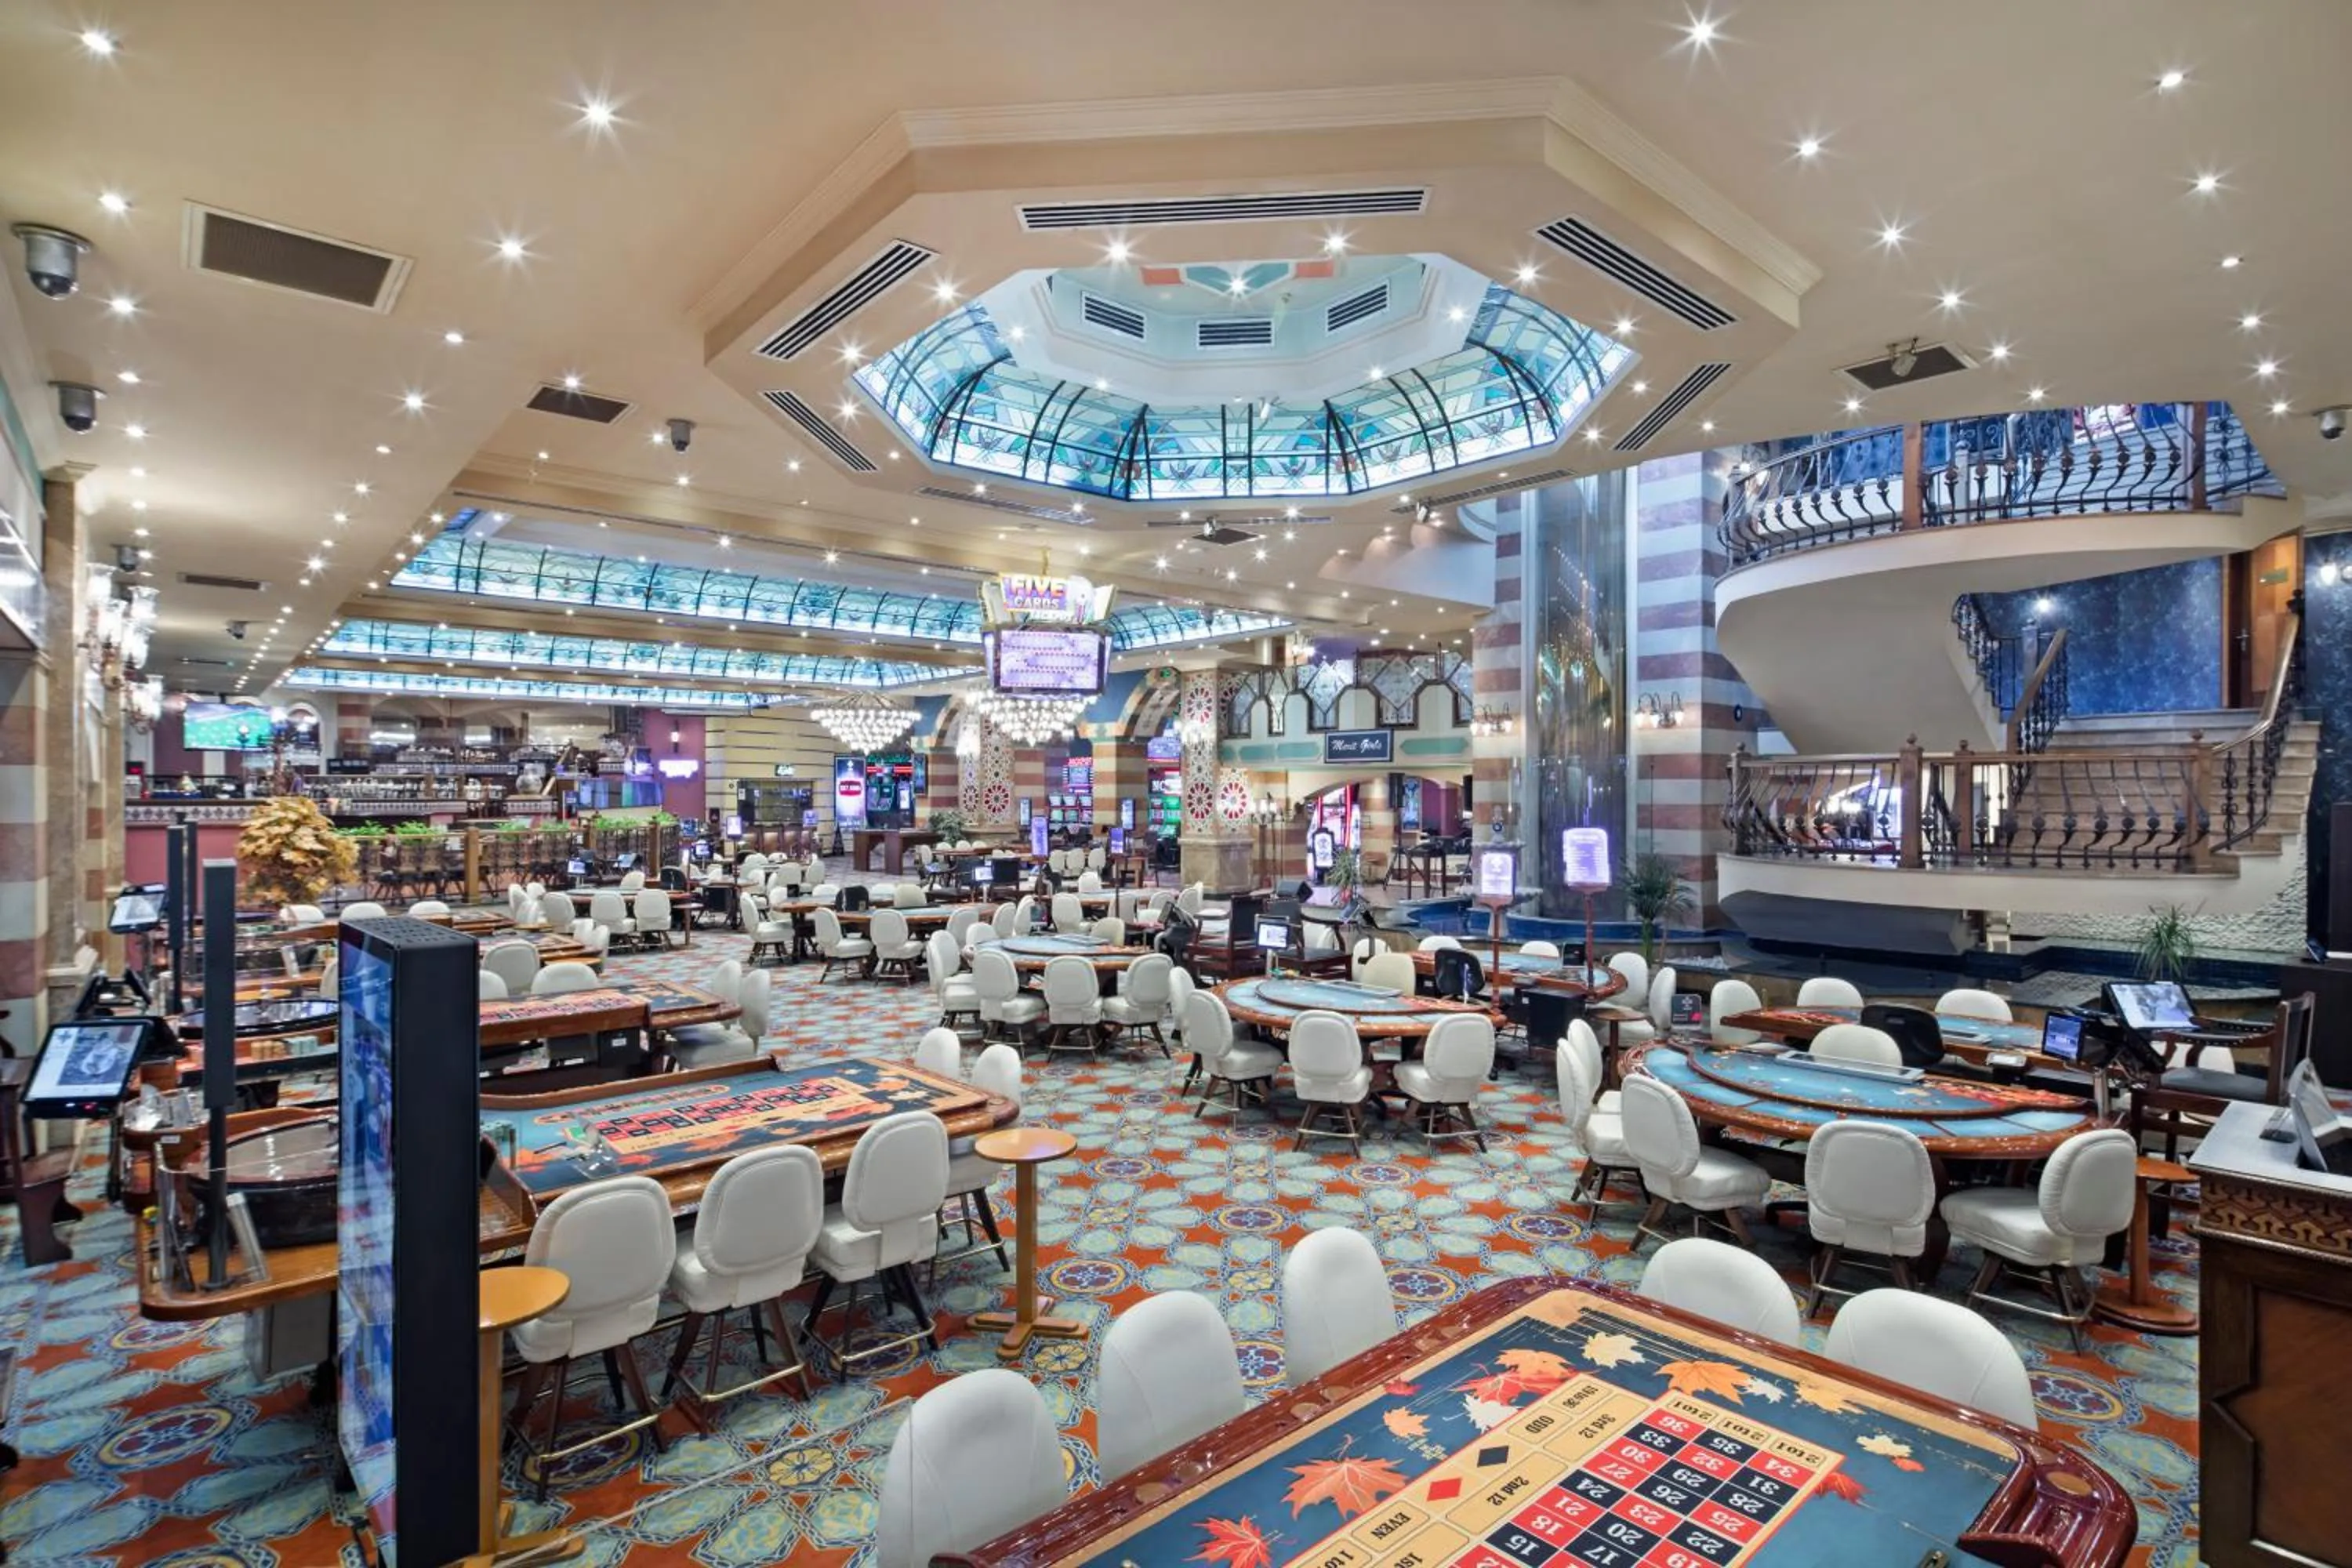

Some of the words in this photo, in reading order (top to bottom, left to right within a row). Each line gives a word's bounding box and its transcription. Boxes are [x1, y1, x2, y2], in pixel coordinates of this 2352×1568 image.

[1008, 575, 1065, 597] FIVE
[1014, 596, 1060, 610] CARDS
[1525, 1415, 1555, 1434] ODD
[1592, 1414, 1616, 1430] 3rd
[1658, 1415, 1690, 1433] 36
[1578, 1427, 1599, 1439] 12
[1639, 1430, 1672, 1448] 33
[1620, 1445, 1653, 1464] 30
[1709, 1436, 1743, 1455] 35
[1599, 1462, 1634, 1480] 27
[1690, 1451, 1725, 1471] 32
[1764, 1457, 1799, 1479] 34
[1501, 1475, 1530, 1496] 2nd
[1575, 1477, 1611, 1498] 24
[1672, 1468, 1708, 1487] 29
[1748, 1475, 1780, 1495] 31
[1486, 1492, 1507, 1506] 12
[1651, 1484, 1688, 1505] 26
[1728, 1492, 1766, 1514] 28
[1554, 1495, 1588, 1515] 21
[1628, 1504, 1666, 1525] 23
[1370, 1512, 1412, 1540] EVEN
[1530, 1514, 1565, 1536] 18
[1708, 1511, 1746, 1533] 25
[1607, 1523, 1644, 1545] 20
[1686, 1531, 1725, 1554] 22
[1504, 1534, 1540, 1556] 15
[1583, 1545, 1621, 1566] 17
